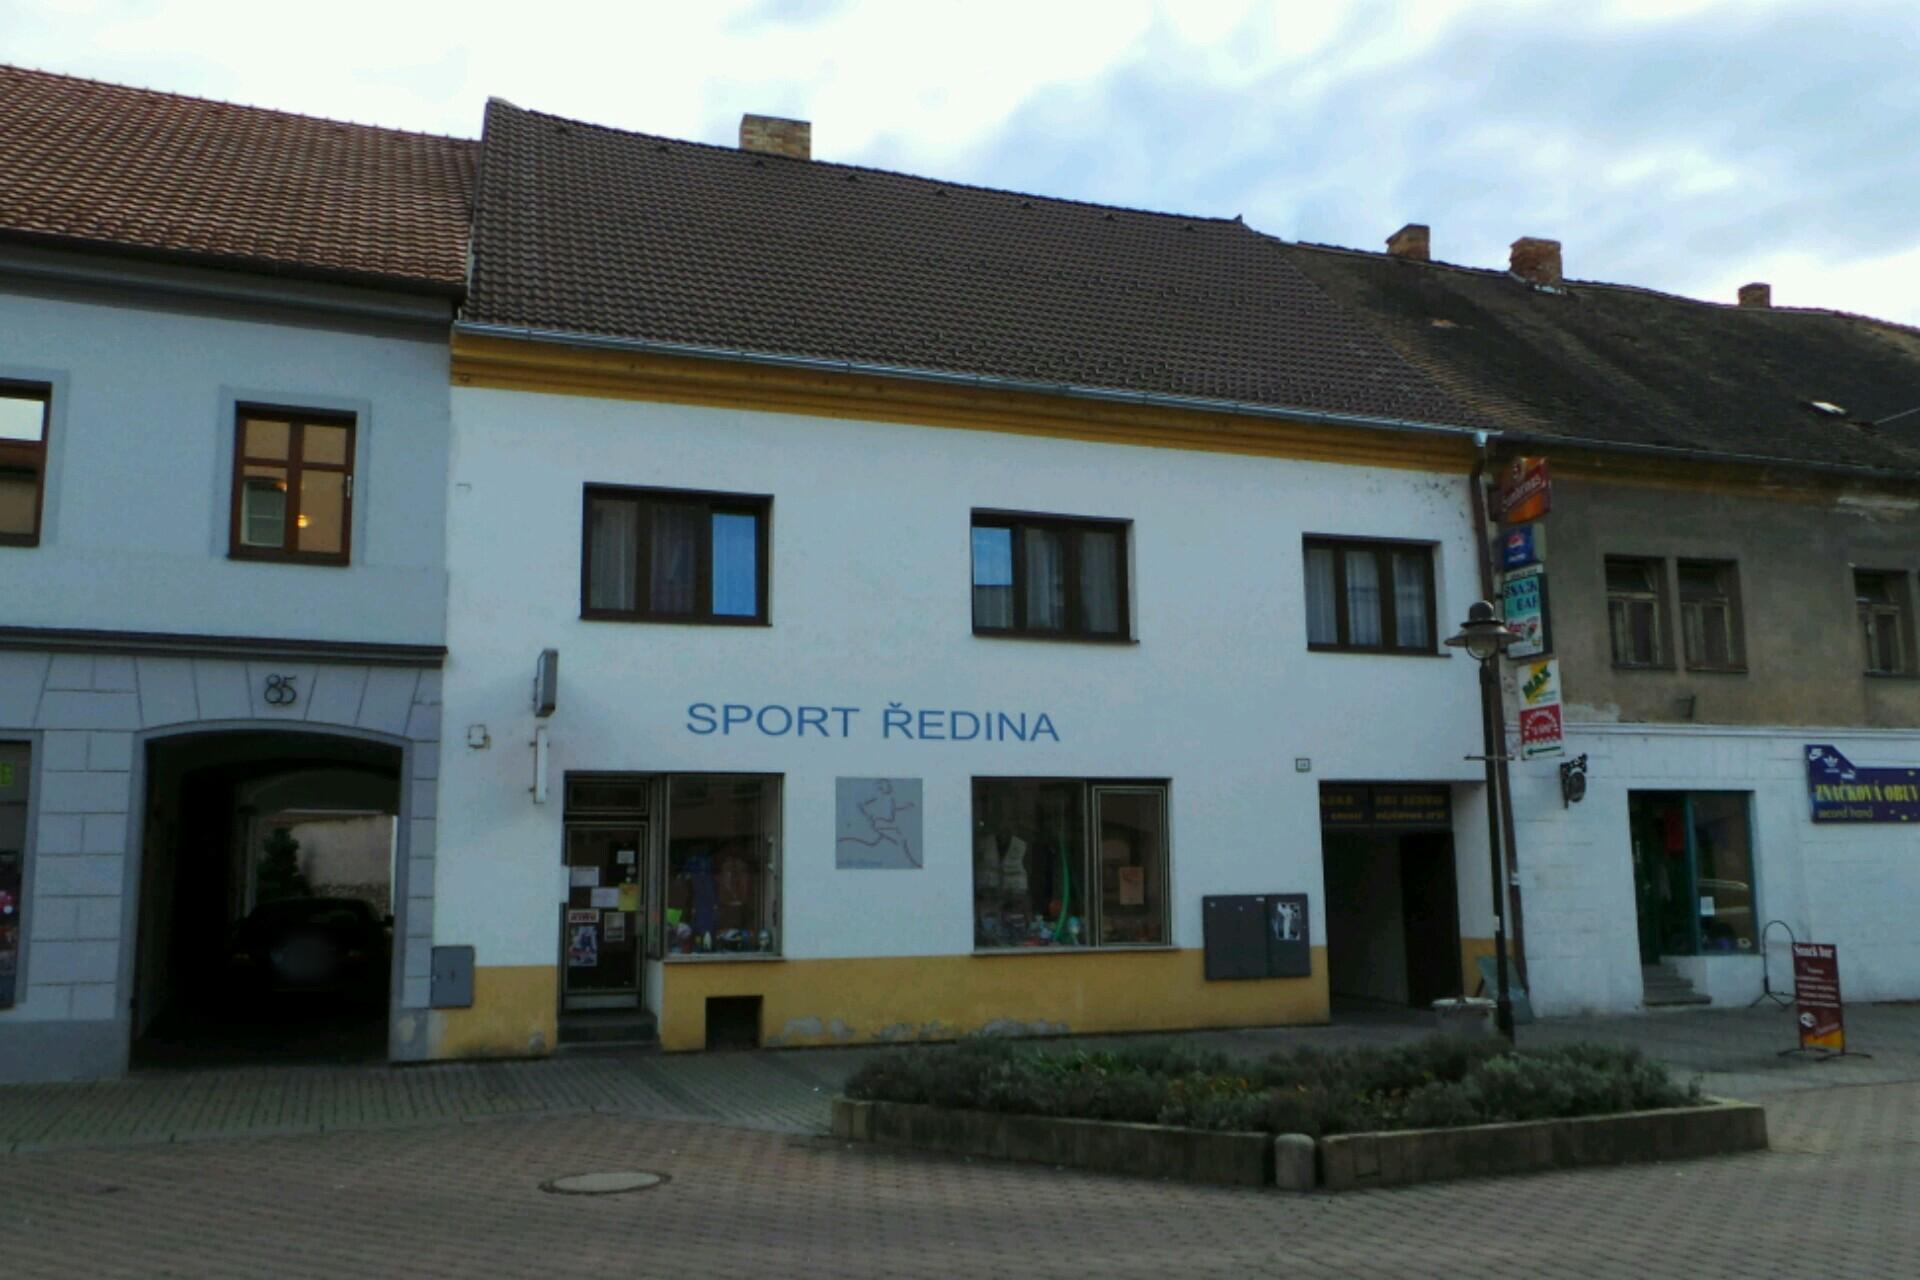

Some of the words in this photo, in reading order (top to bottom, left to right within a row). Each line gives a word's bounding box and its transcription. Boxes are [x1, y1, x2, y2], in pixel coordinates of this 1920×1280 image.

[264, 674, 297, 705] 85
[1522, 665, 1551, 700] MAX
[686, 703, 860, 738] SPORT
[882, 702, 1060, 742] ŘEDINA
